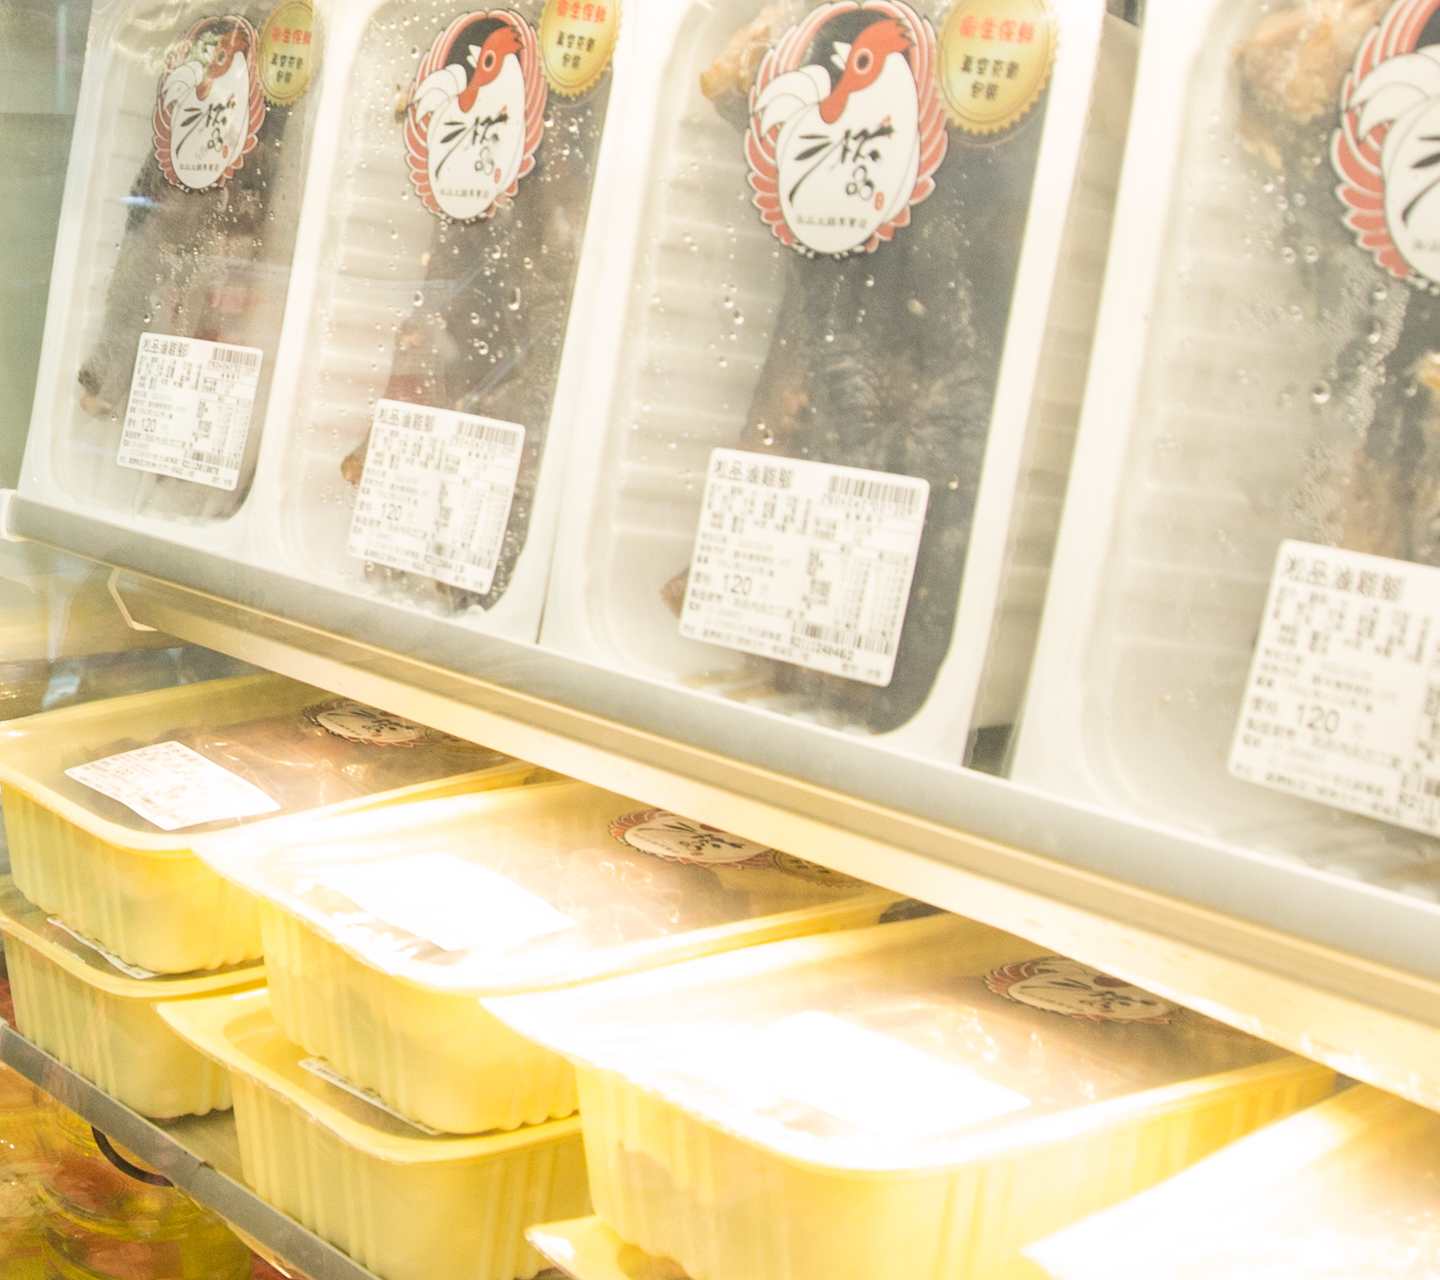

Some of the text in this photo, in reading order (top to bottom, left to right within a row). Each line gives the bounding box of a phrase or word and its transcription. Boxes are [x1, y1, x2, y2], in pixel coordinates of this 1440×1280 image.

[141, 418, 157, 433] 120
[382, 503, 403, 521] 120
[723, 574, 753, 596] 120
[1295, 702, 1341, 734] 120
